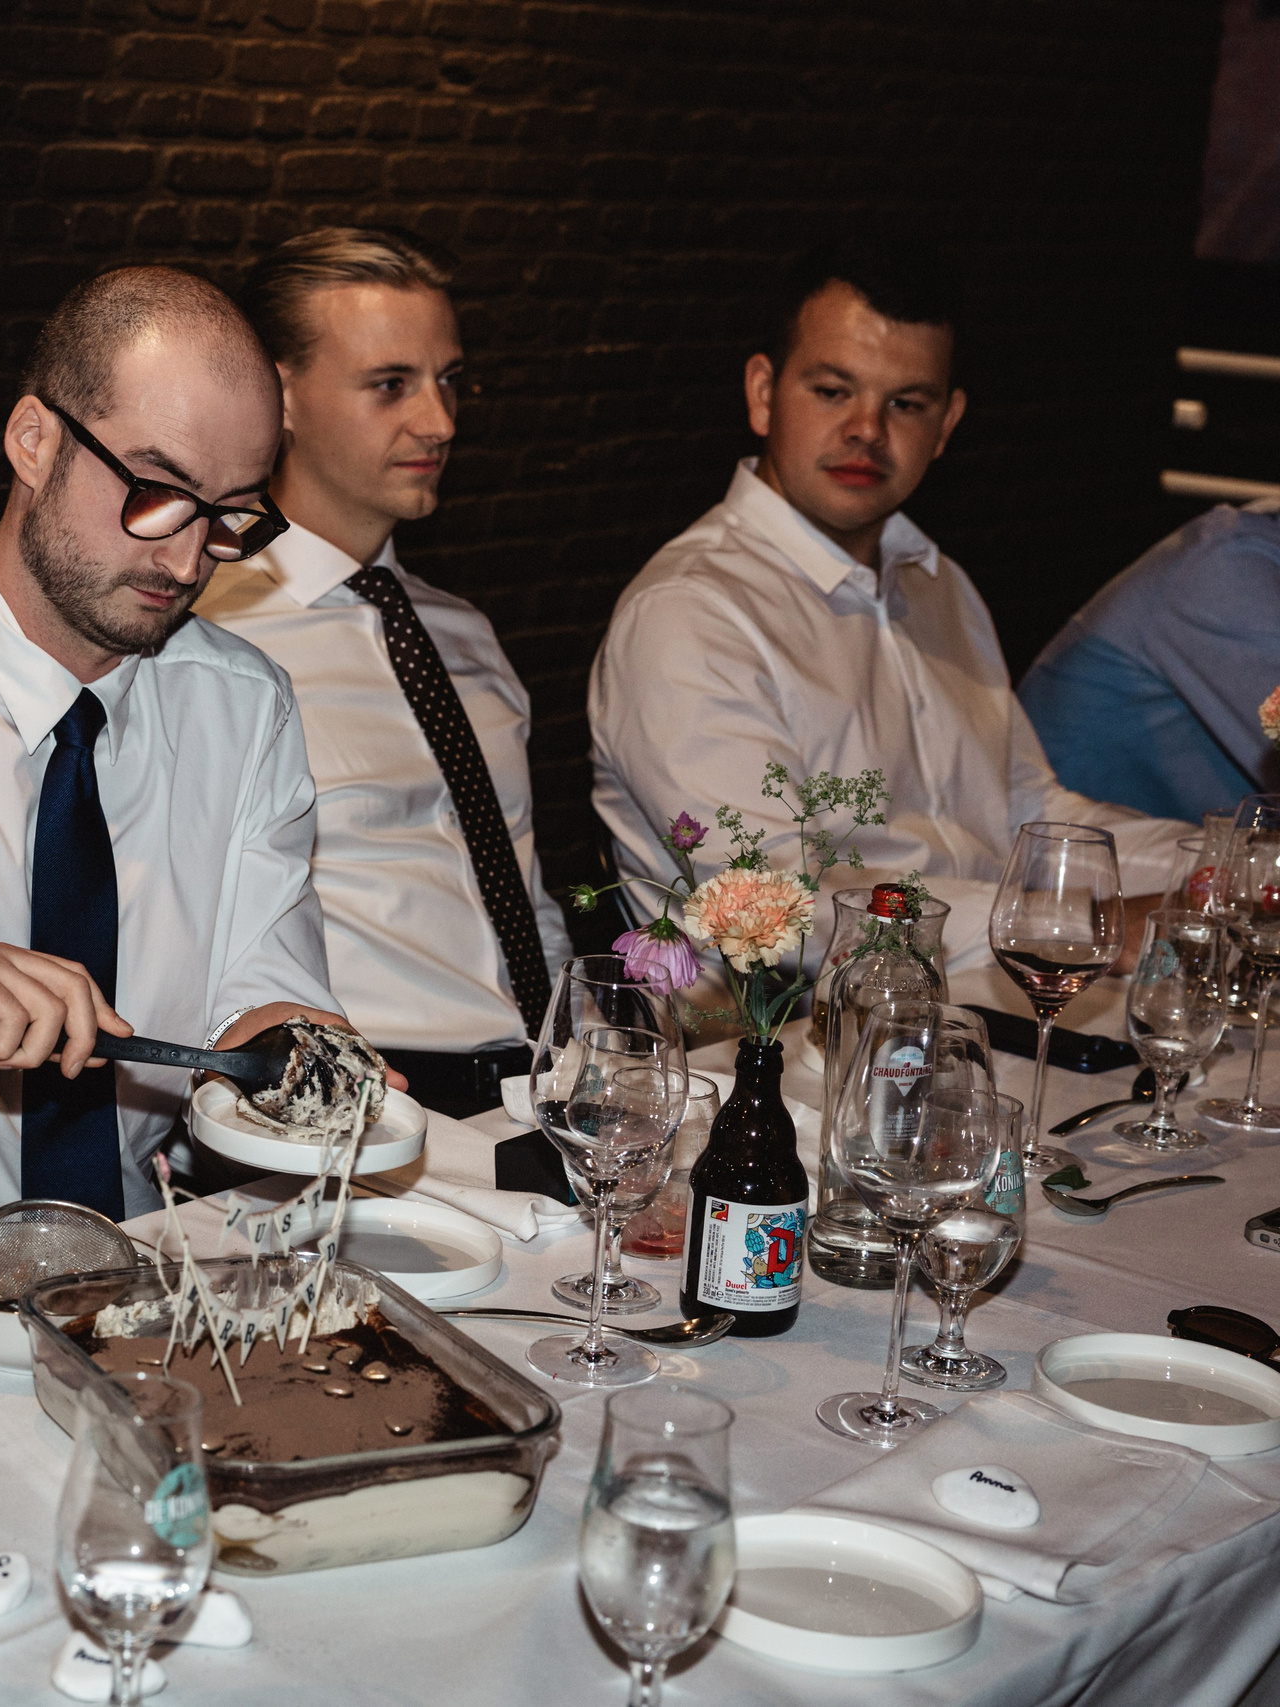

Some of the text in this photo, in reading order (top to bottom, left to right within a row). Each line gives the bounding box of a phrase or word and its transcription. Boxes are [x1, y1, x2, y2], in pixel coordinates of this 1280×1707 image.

[873, 1064, 932, 1078] CHAUDFONTAINE
[226, 1189, 321, 1243] JUST
[725, 1279, 748, 1290] Duvel
[969, 1470, 1017, 1493] Anna
